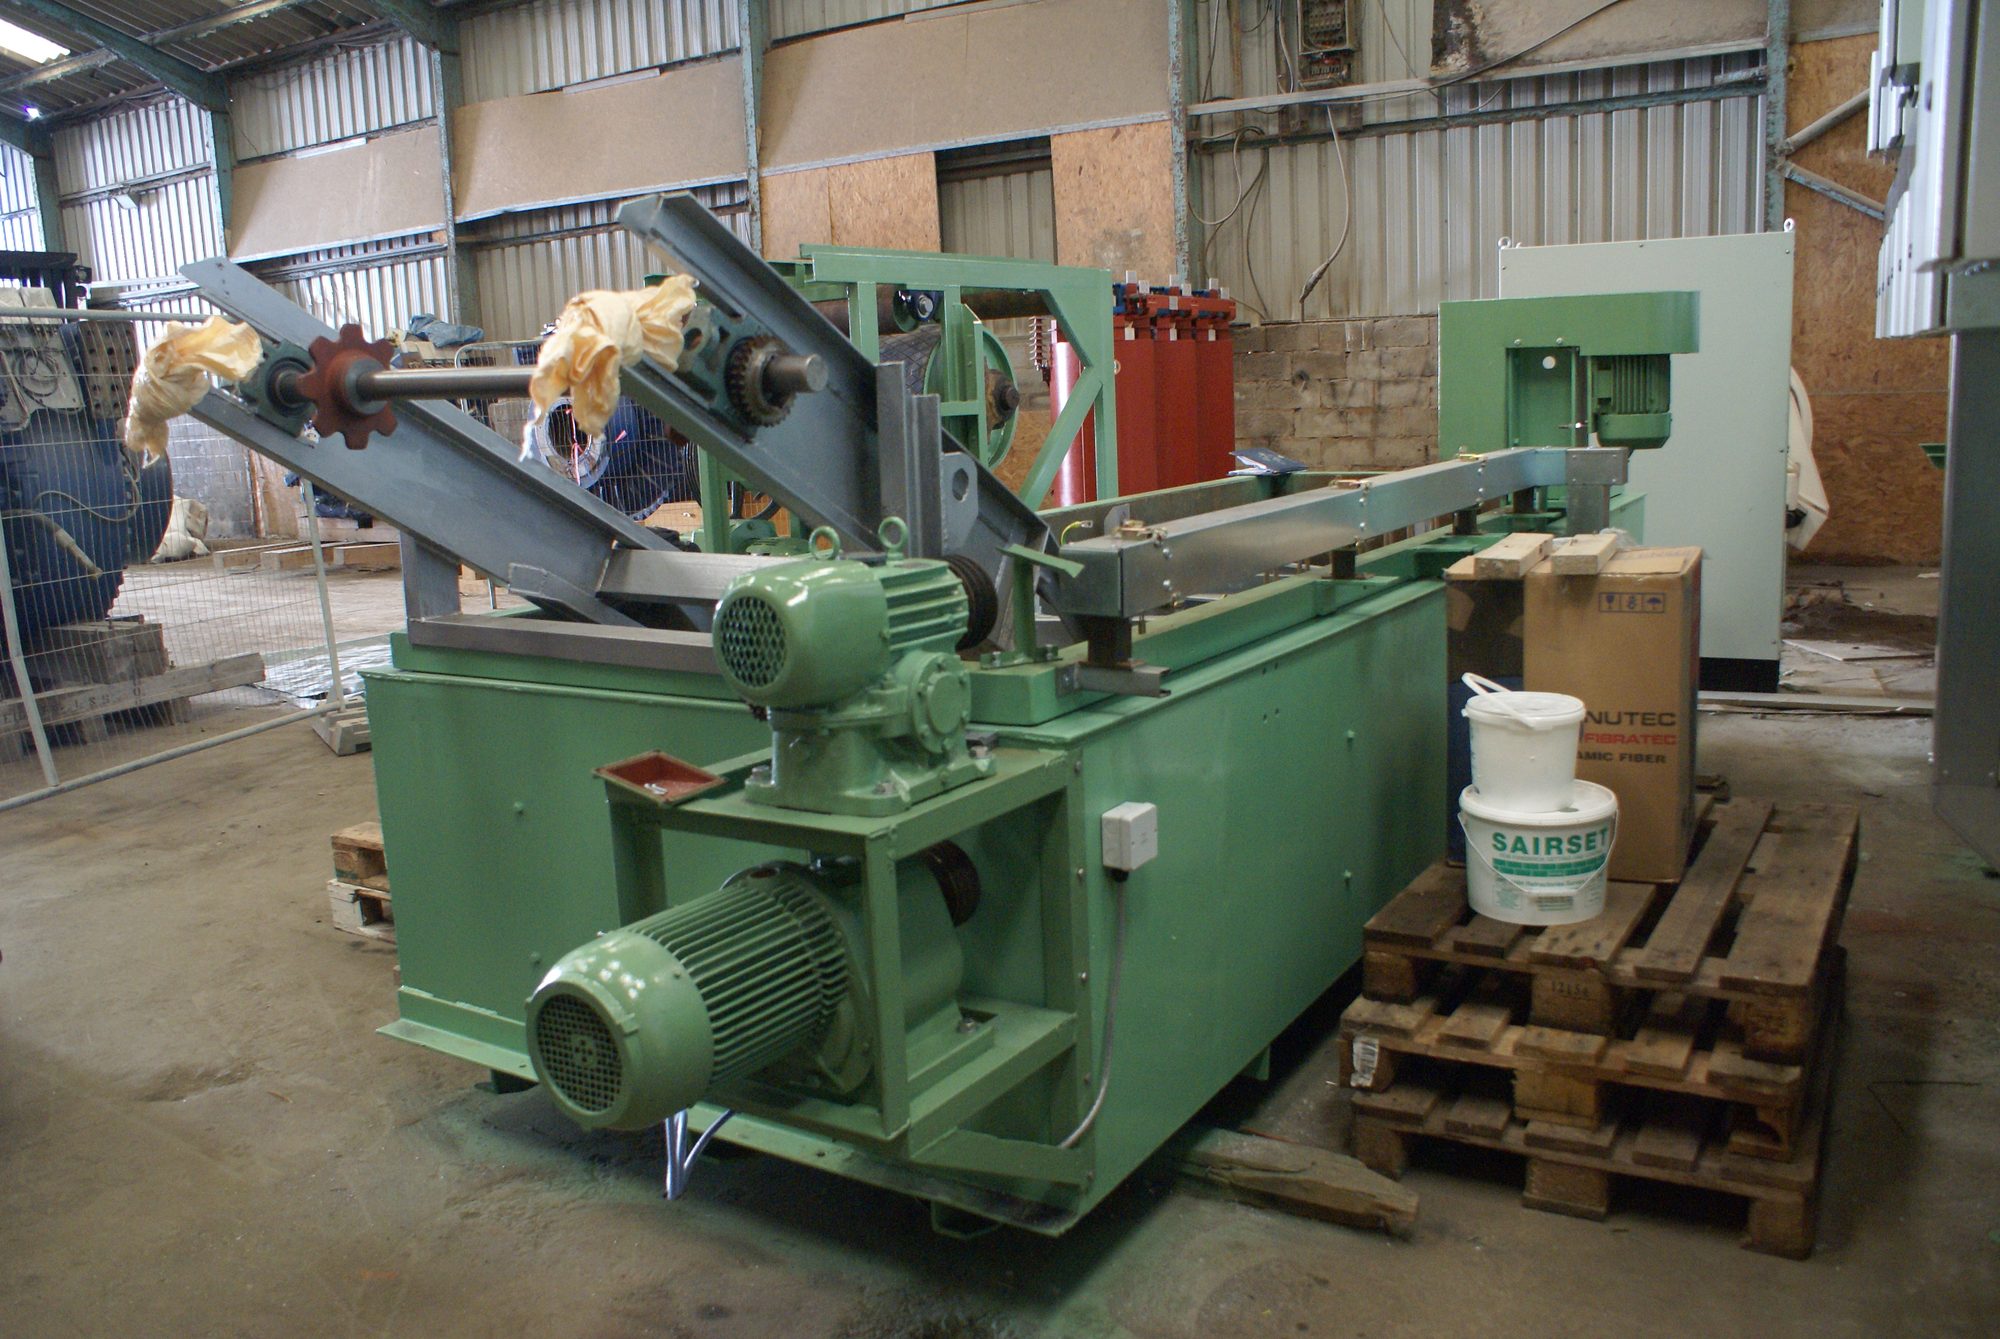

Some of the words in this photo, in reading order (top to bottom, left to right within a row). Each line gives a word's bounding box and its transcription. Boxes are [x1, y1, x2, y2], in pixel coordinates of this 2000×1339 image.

[1584, 711, 1676, 726] NUTEC
[1584, 733, 1677, 745] FIBRATEC
[1577, 751, 1614, 762] AMIC
[1619, 753, 1667, 763] FIBER
[1491, 828, 1608, 856] SAIRSET
